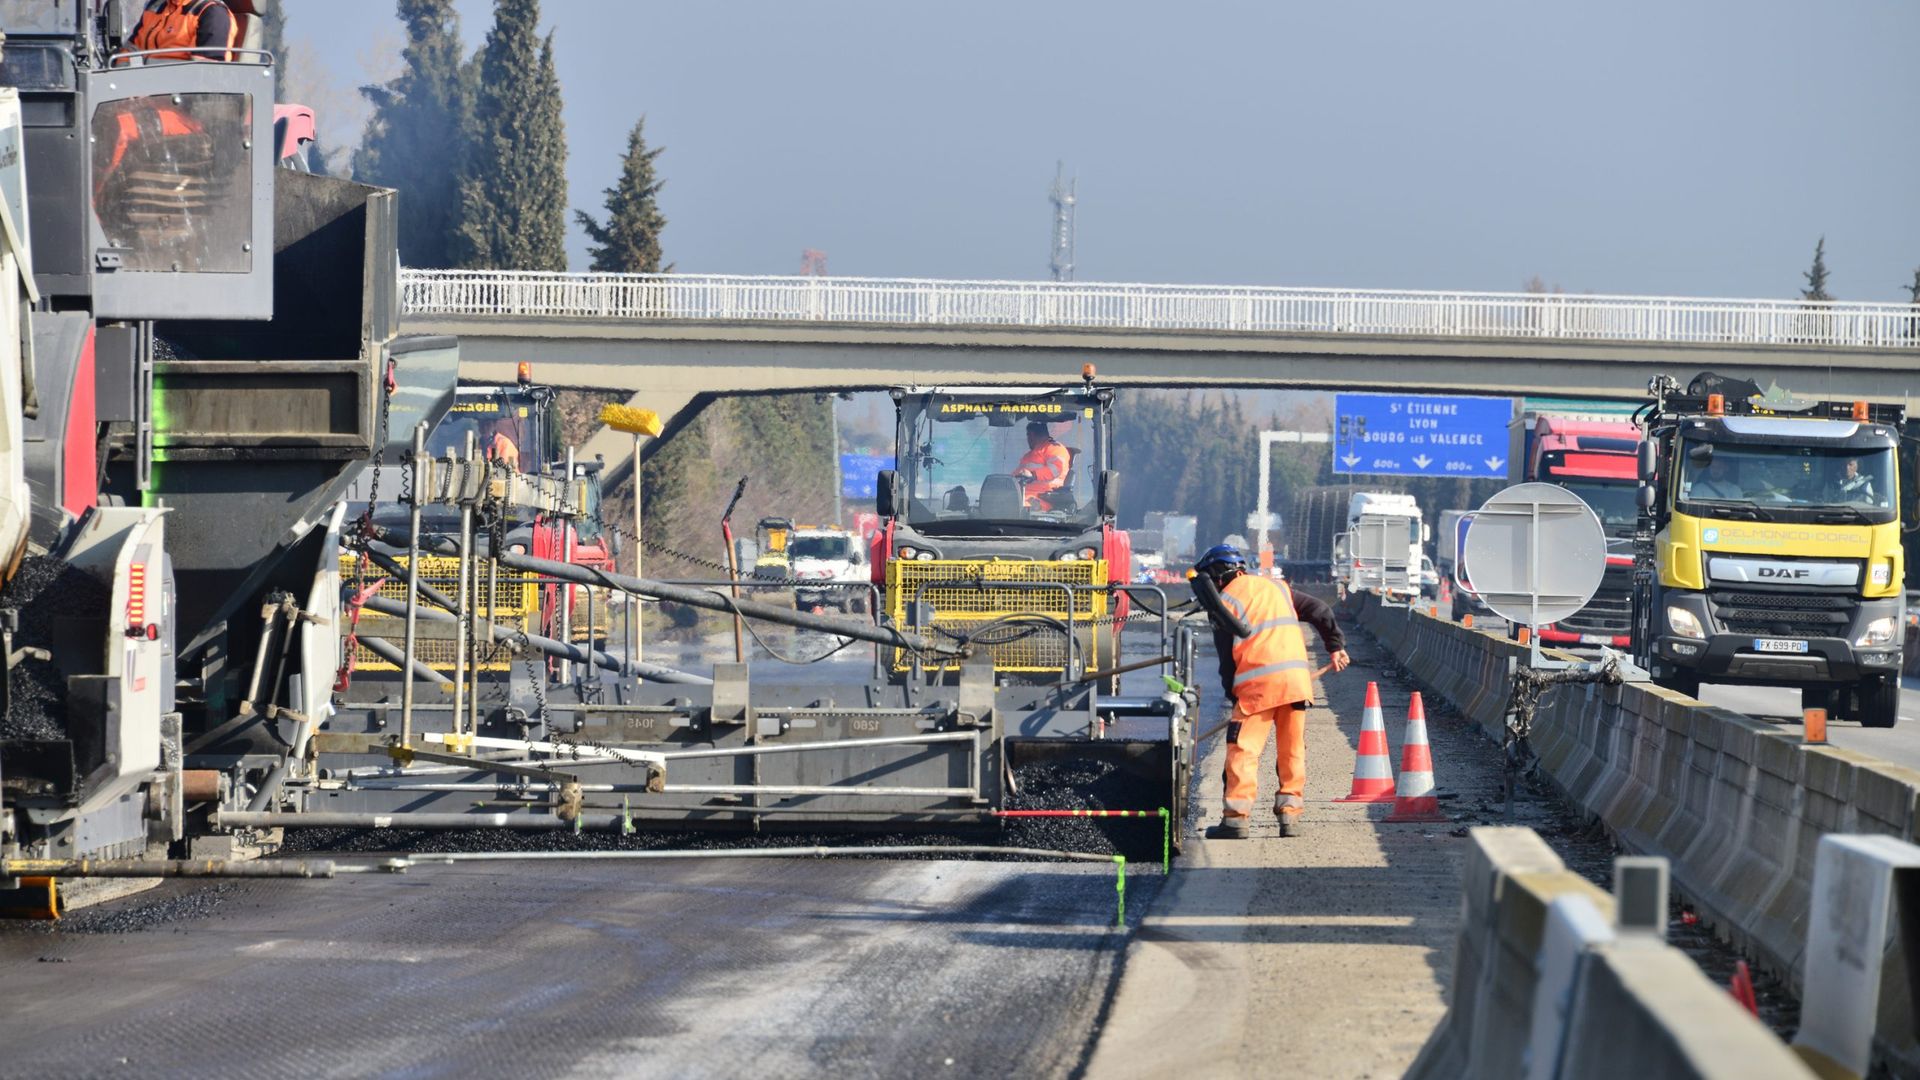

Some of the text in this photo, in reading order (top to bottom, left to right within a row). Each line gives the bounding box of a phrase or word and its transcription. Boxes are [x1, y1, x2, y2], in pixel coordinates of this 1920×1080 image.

[450, 403, 499, 412] ANAGER
[941, 404, 1062, 413] ASPHALT MANAGER
[1408, 402, 1458, 415] ÉTIENNE
[1409, 418, 1438, 429] LYON
[1363, 432, 1405, 443] BOURG
[1430, 434, 1483, 445] VALENCE
[1758, 567, 1809, 579] DAF
